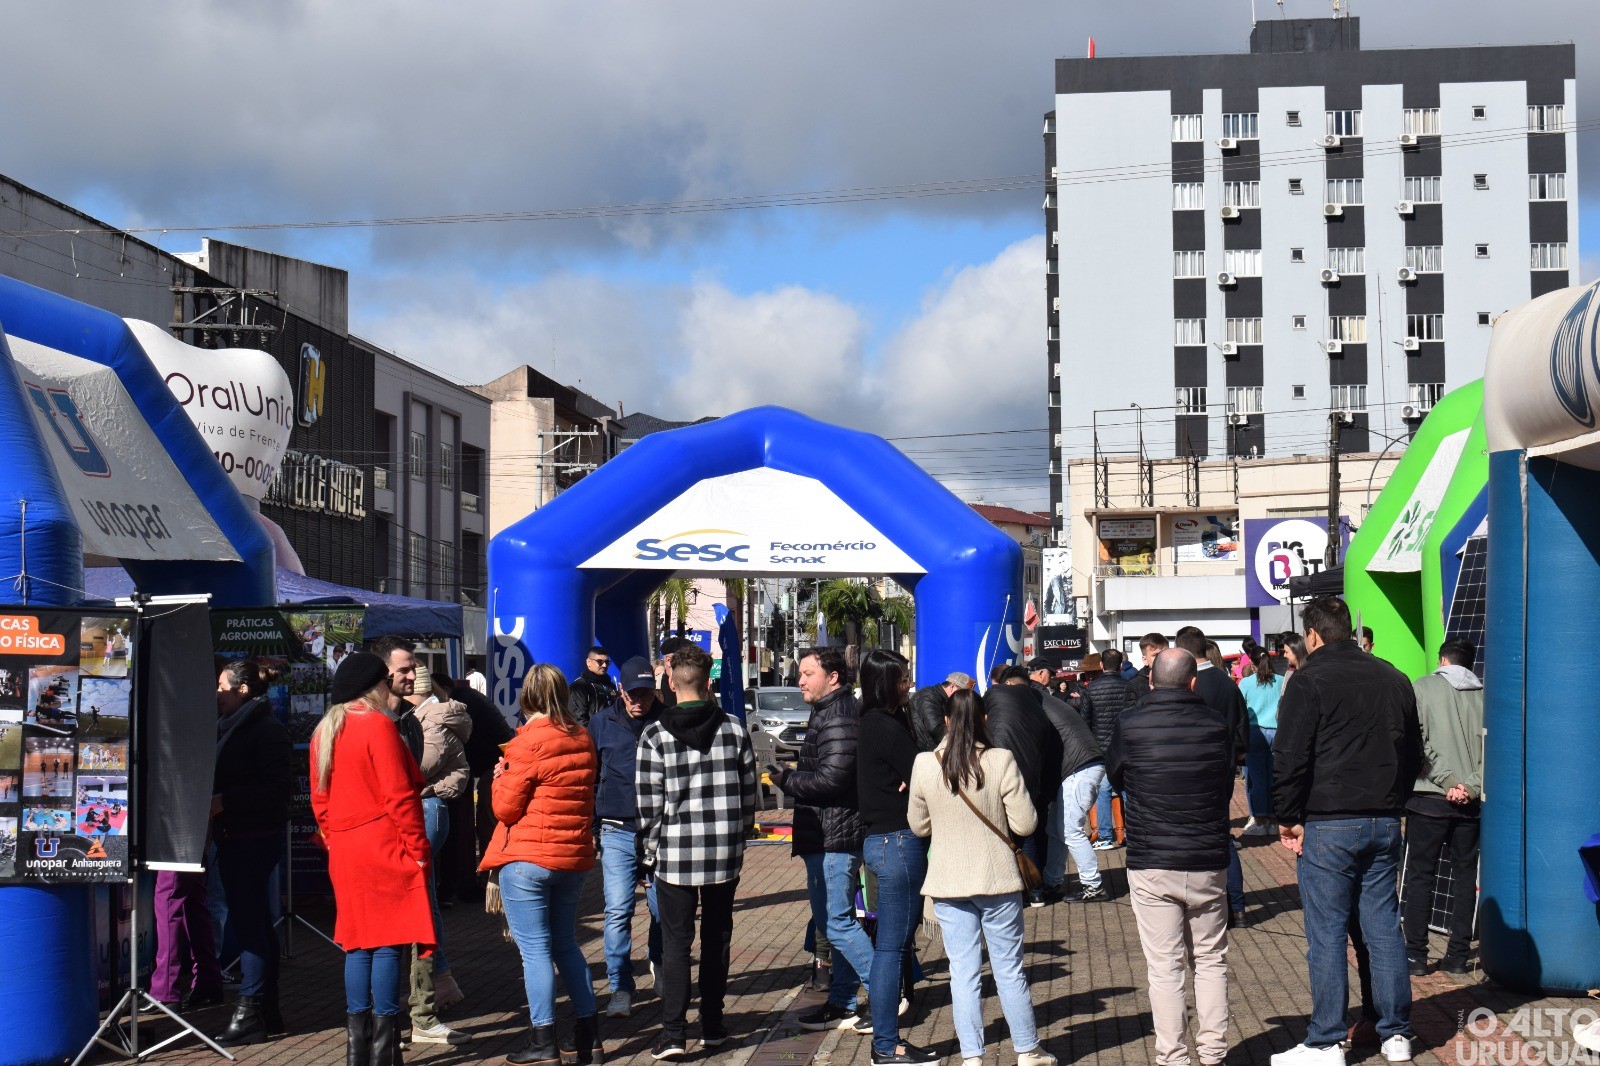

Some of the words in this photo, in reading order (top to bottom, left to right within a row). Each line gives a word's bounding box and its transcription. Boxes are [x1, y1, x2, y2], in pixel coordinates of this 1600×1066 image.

[229, 425, 245, 439] de
[249, 429, 281, 452] Frente
[80, 499, 172, 551] unopar
[635, 538, 750, 562] Sesc
[770, 540, 877, 551] Fecomércio
[769, 555, 826, 564] Senac
[226, 616, 274, 628] PRÁTICAS
[15, 632, 60, 649] FÍSICA
[219, 631, 283, 641] AGRONOMIA
[1043, 639, 1081, 647] EXECUTIVE
[26, 859, 68, 870] unopar
[71, 858, 122, 869] Anhanguera
